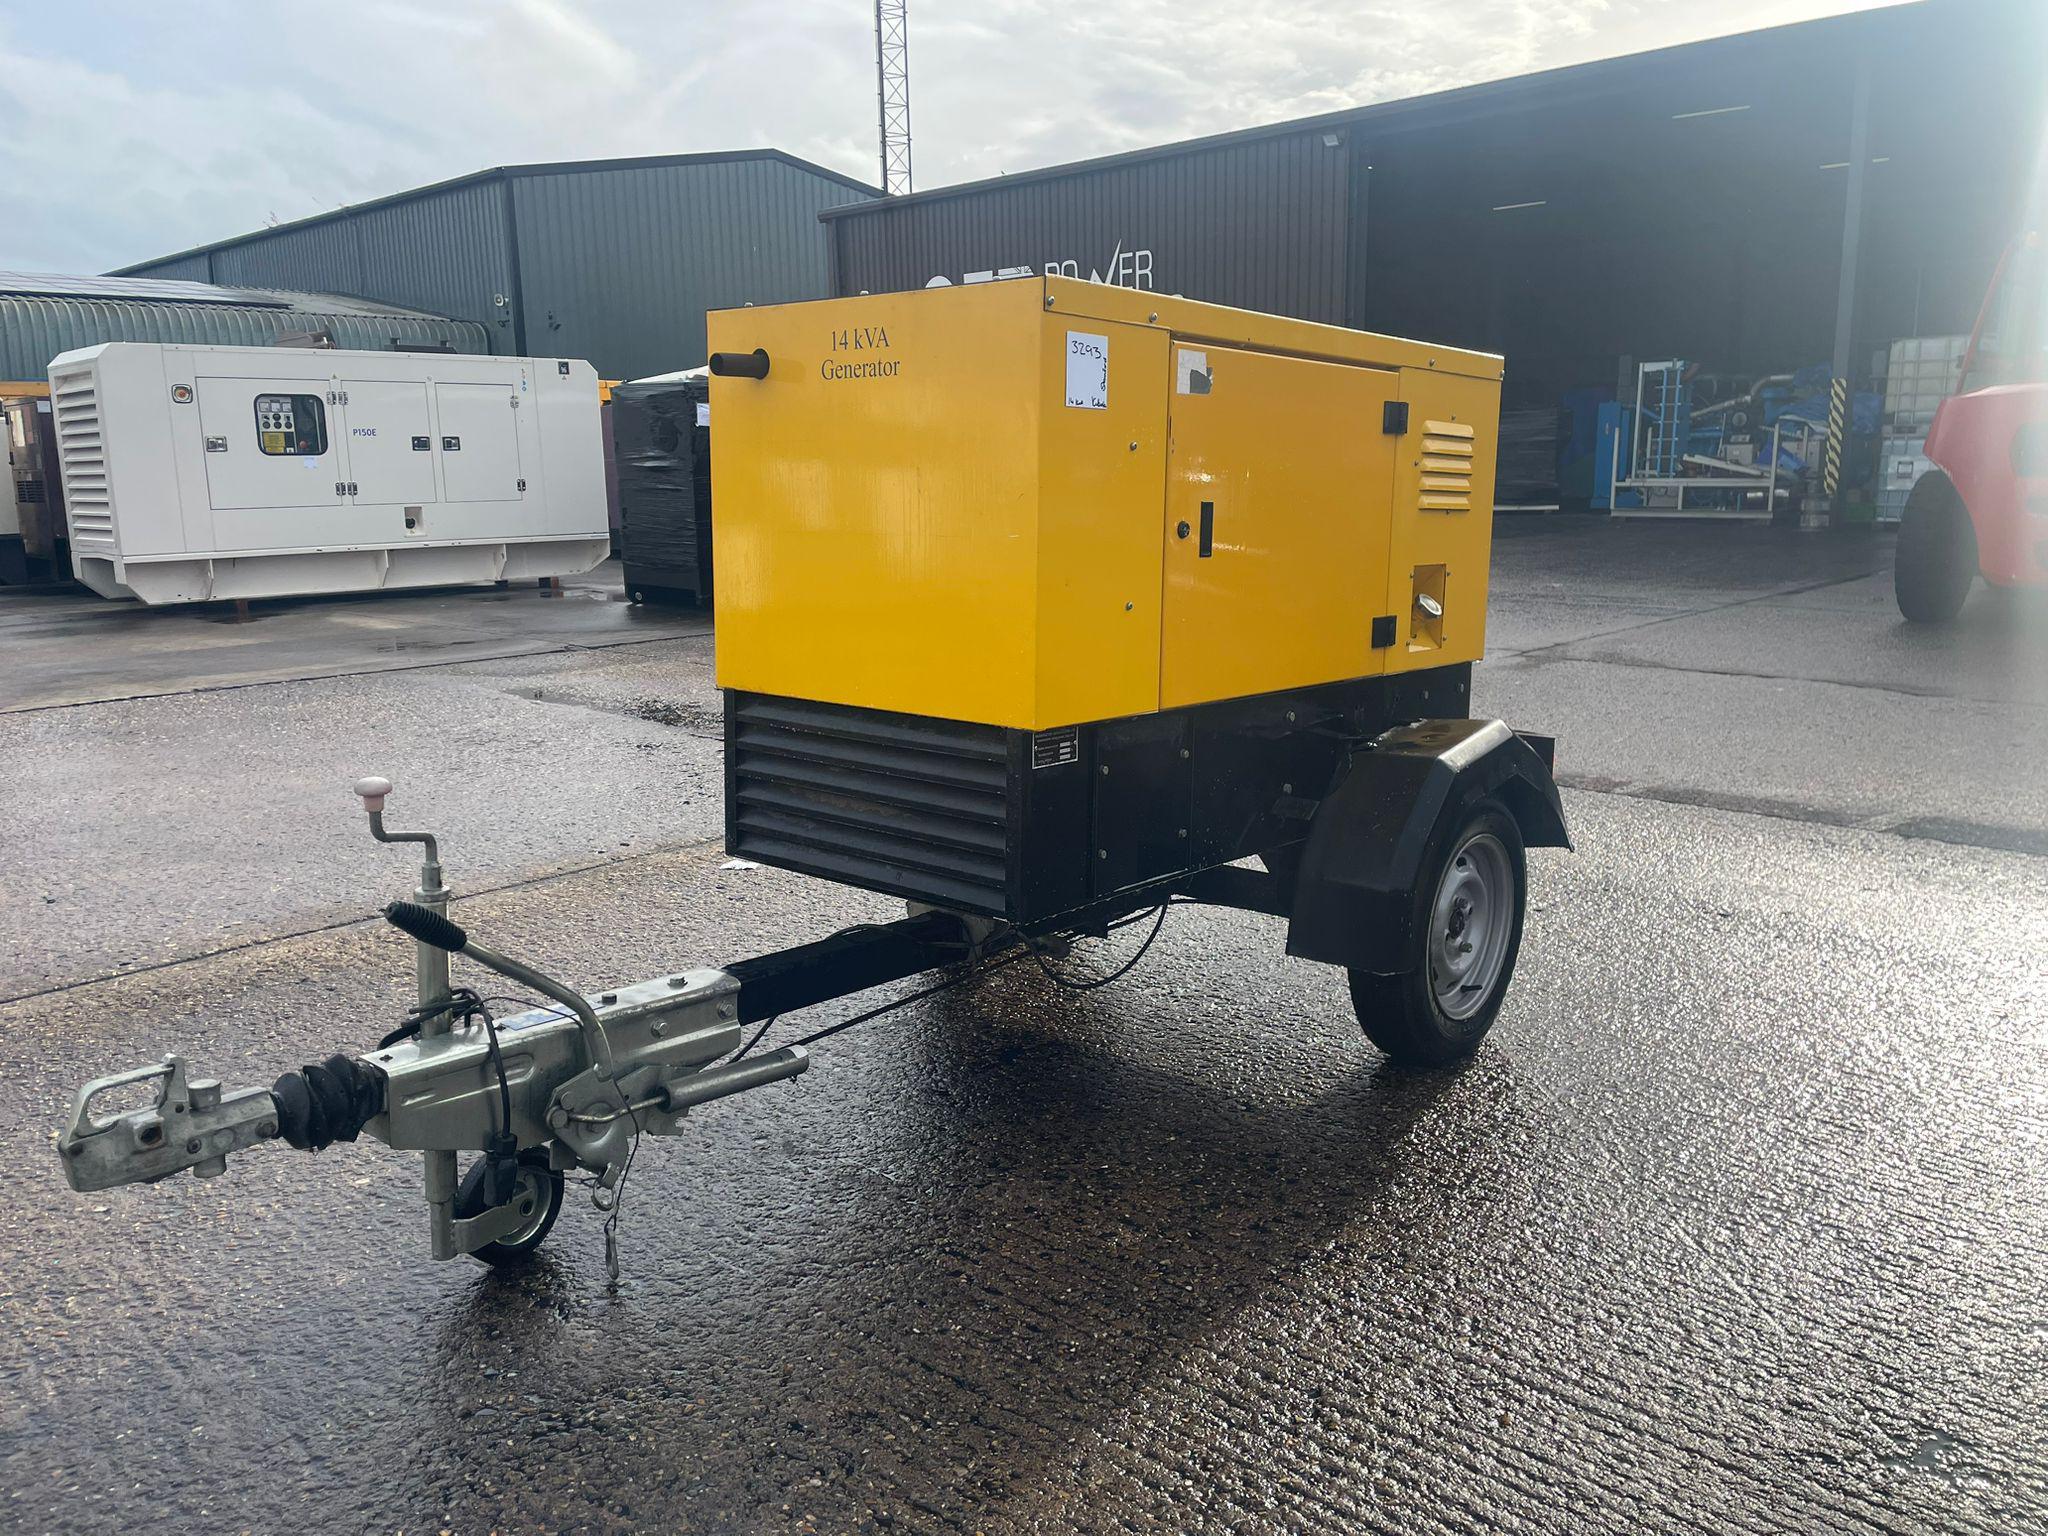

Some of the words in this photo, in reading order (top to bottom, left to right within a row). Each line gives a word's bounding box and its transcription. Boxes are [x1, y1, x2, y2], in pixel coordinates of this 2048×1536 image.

[832, 329, 849, 352] 14
[854, 326, 890, 350] kVA
[1072, 340, 1102, 359] 3293
[821, 359, 900, 380] Generator
[352, 428, 377, 437] P150E
